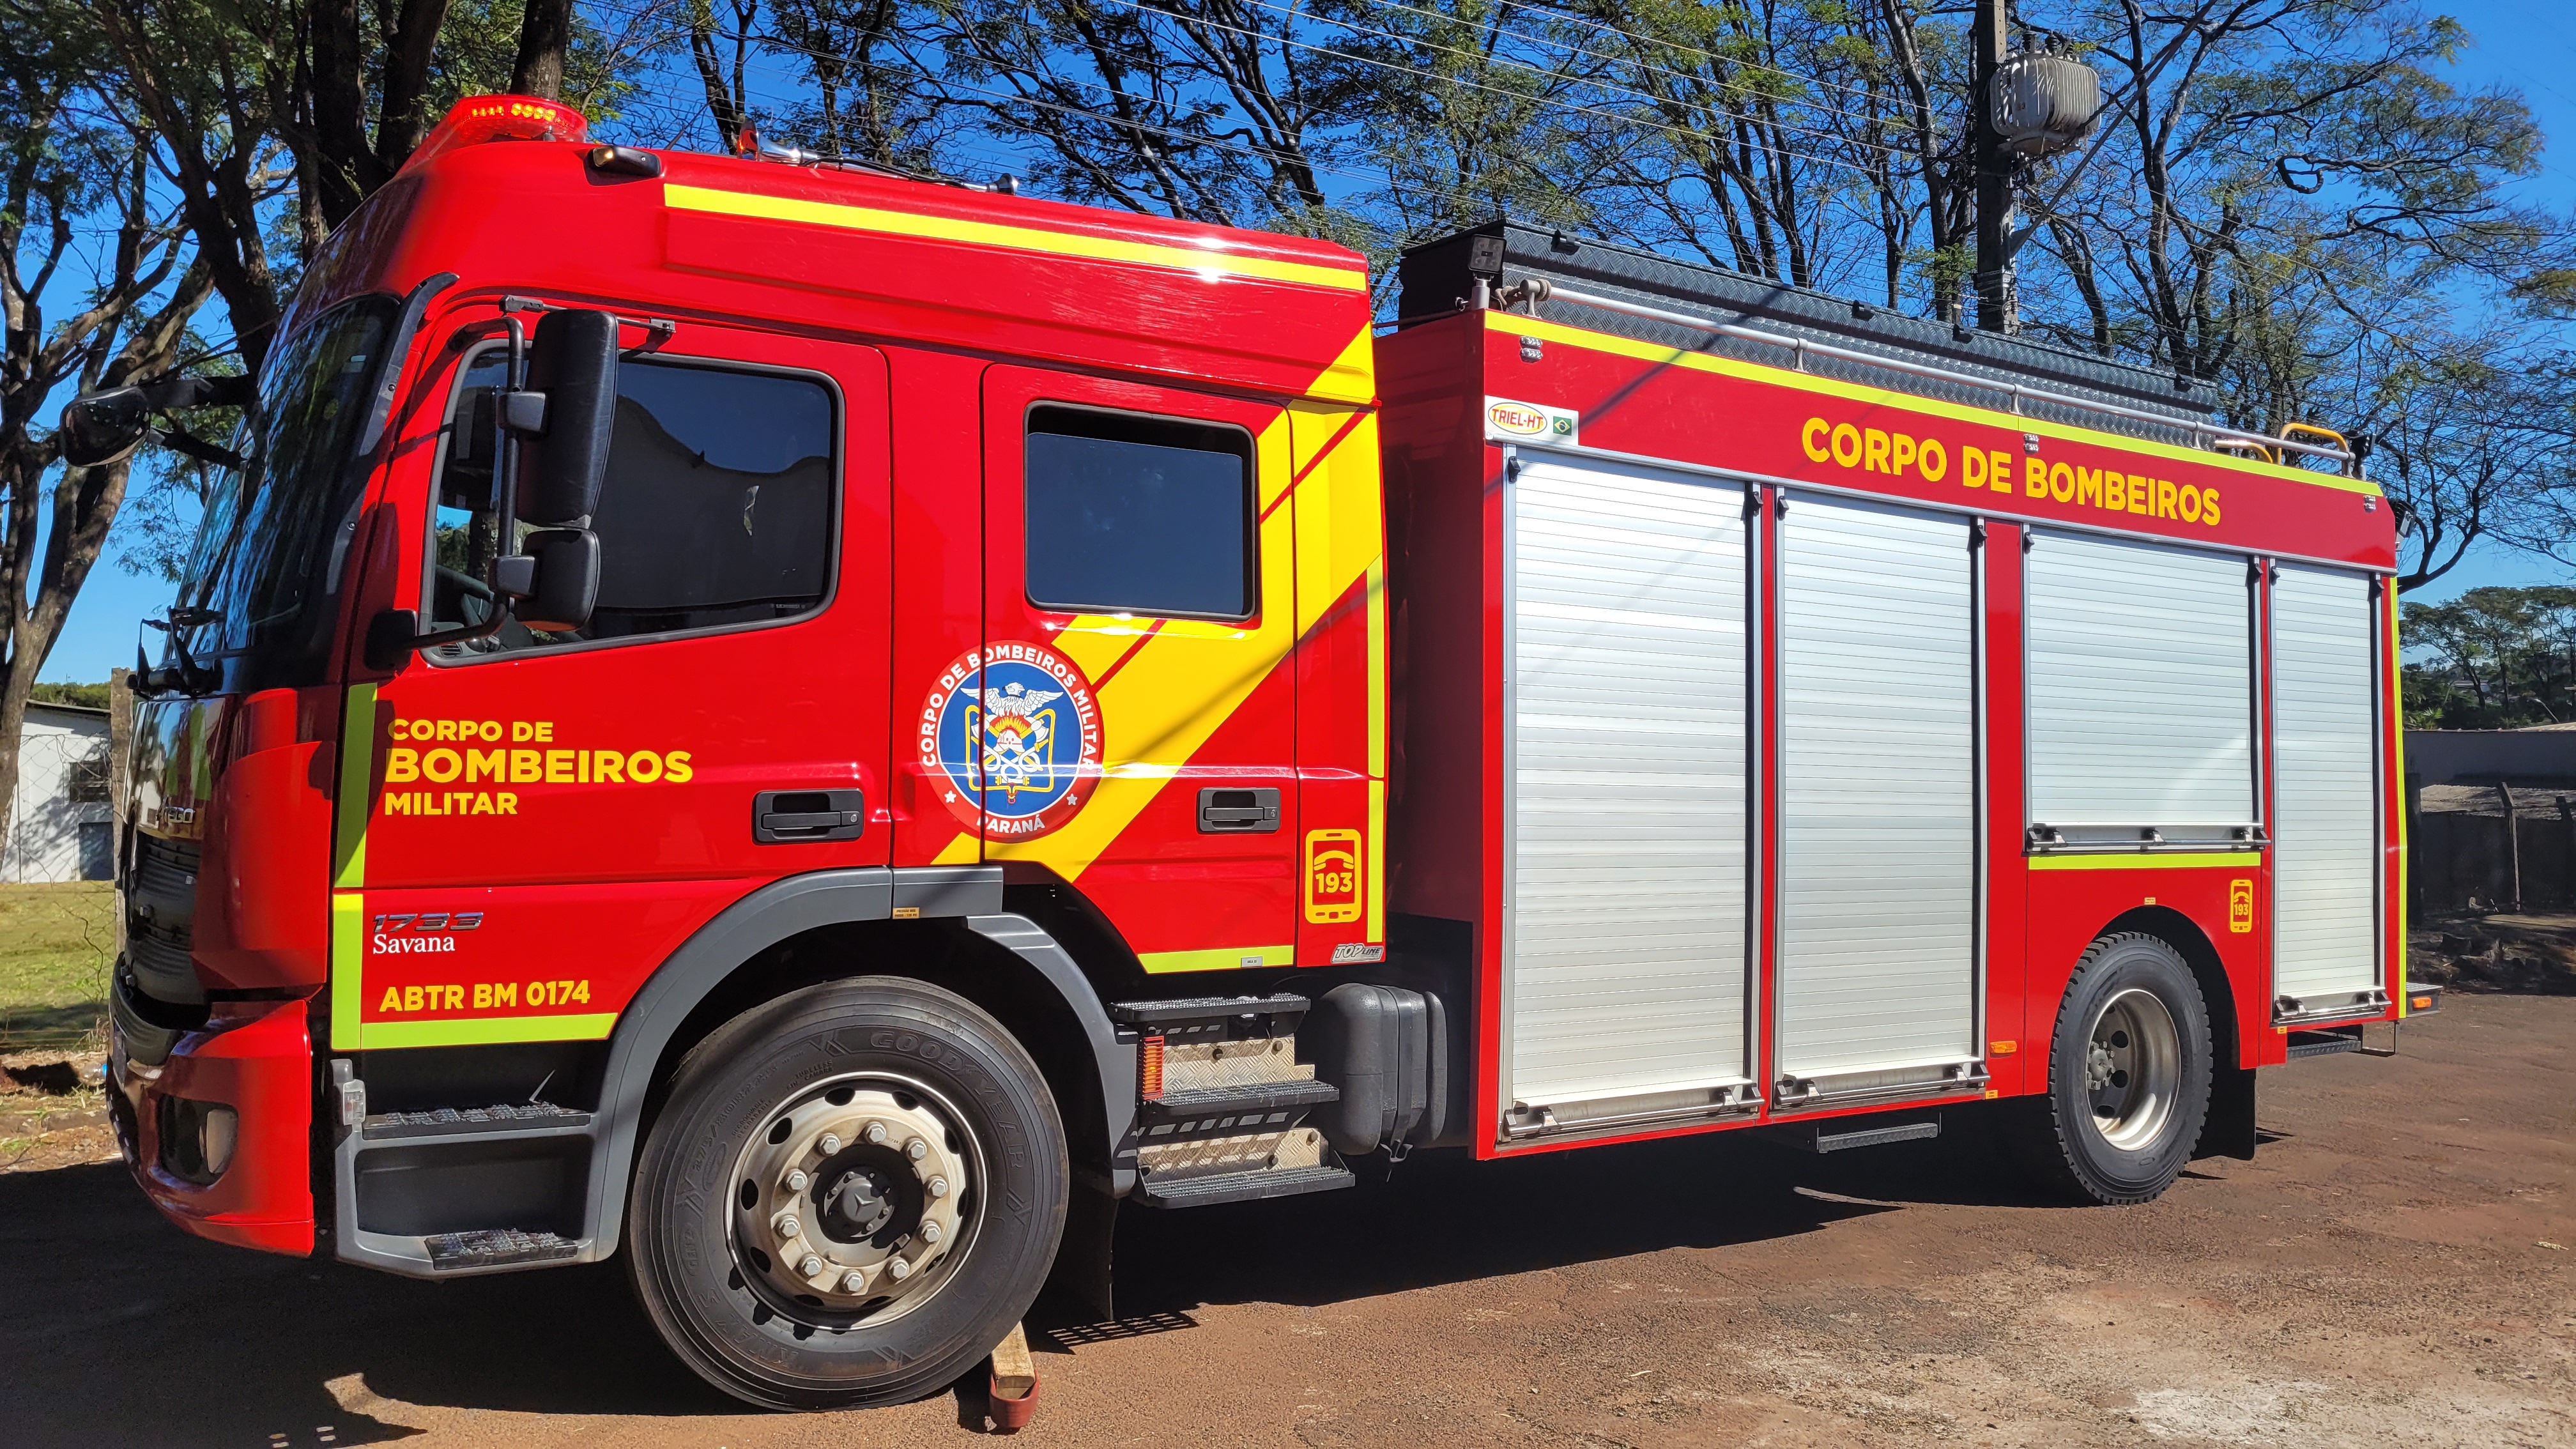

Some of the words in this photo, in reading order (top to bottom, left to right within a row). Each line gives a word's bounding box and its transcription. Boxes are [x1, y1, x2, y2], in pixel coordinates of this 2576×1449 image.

[1492, 408, 1544, 430] TRIEL-HT
[1802, 417, 1948, 483] CORPO
[1963, 445, 2012, 494] DE
[2025, 457, 2221, 526] BOMBEIROS
[920, 693, 944, 767] CORPO
[940, 663, 967, 691] DE
[966, 644, 1077, 688] BOMBEIROS
[1073, 688, 1100, 770] MILITAR
[387, 718, 503, 742] CORPO
[512, 721, 553, 742] DE
[385, 748, 694, 783] BOMBEIROS
[385, 792, 518, 816] MILITAR
[1315, 871, 1353, 894] 193
[2234, 903, 2249, 916] 193
[373, 912, 484, 934] 1733
[373, 933, 456, 954] Savana
[379, 985, 464, 1013] ABTR
[473, 983, 518, 1009] BM
[526, 979, 590, 1006] 0174
[870, 1031, 1026, 1169] GOODYEAR
